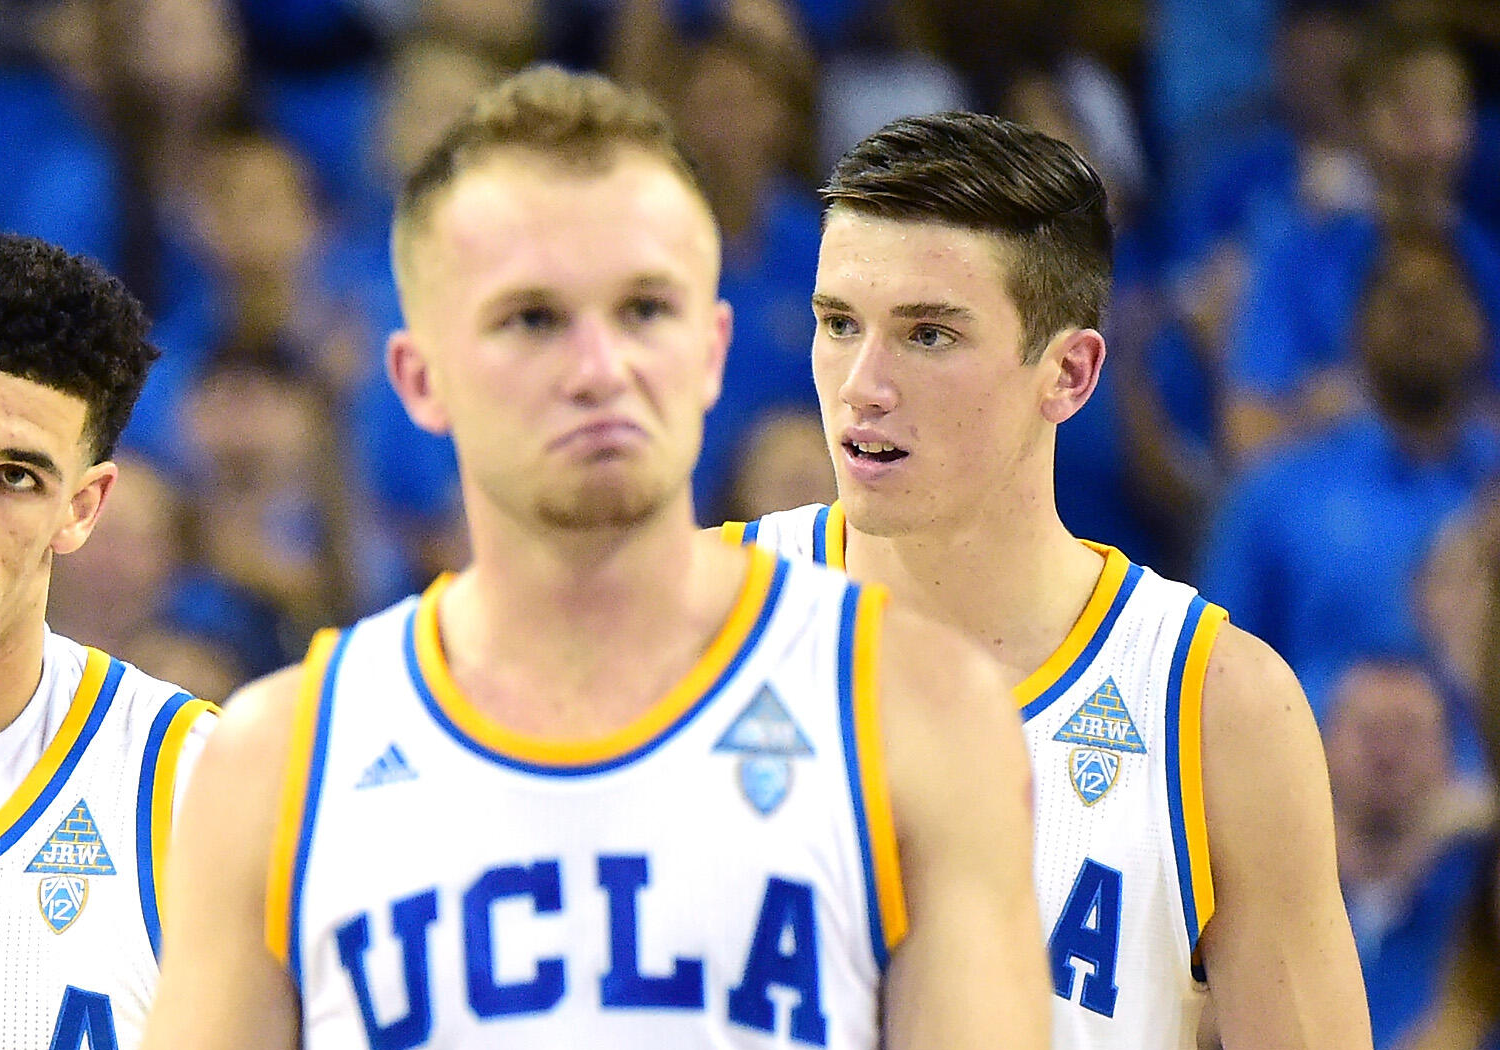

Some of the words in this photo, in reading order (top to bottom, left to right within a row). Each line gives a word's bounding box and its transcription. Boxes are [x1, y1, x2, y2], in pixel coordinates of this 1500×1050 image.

[1071, 716, 1131, 742] JRW
[1073, 750, 1119, 786] PAC
[1080, 771, 1104, 795] 12
[43, 844, 101, 866] JRW
[40, 876, 85, 911] PAC
[48, 899, 73, 921] 12
